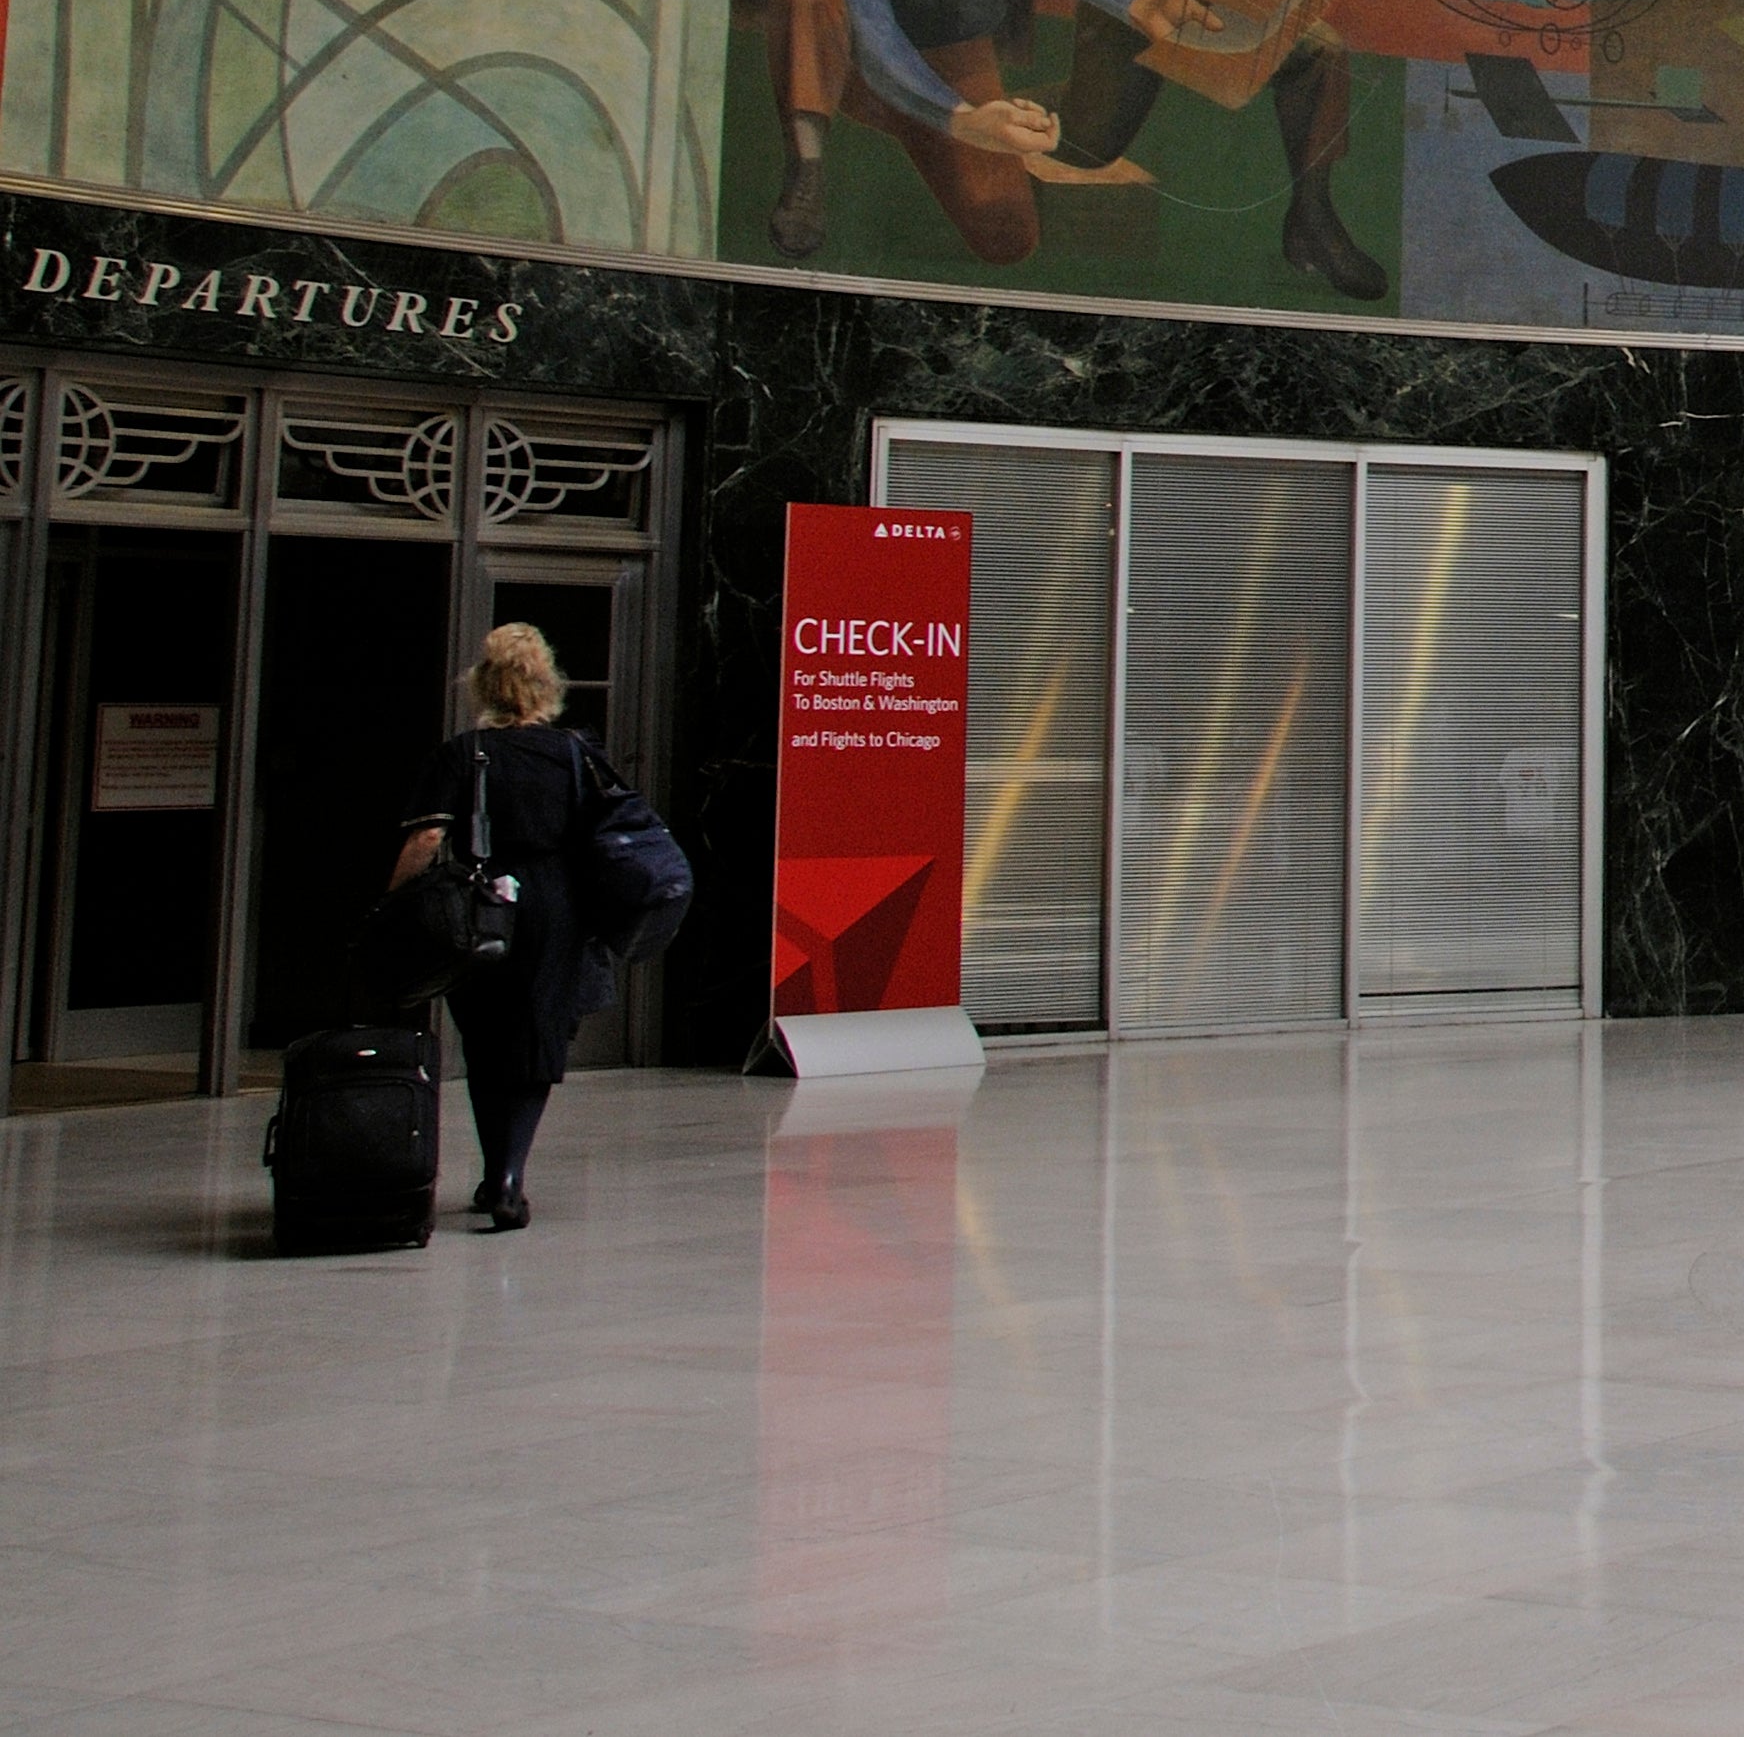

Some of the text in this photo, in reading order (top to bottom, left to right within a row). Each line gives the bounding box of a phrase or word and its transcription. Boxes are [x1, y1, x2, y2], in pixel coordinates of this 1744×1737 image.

[23, 248, 525, 344] DEPARTURES
[892, 525, 945, 539] DELTA
[794, 617, 961, 657] CHECK-IN
[793, 670, 914, 690] For Shuttle Flights
[794, 694, 958, 714] To Boston & Washington
[129, 712, 201, 728] WARNING
[792, 732, 940, 751] and Flights to Chicago
